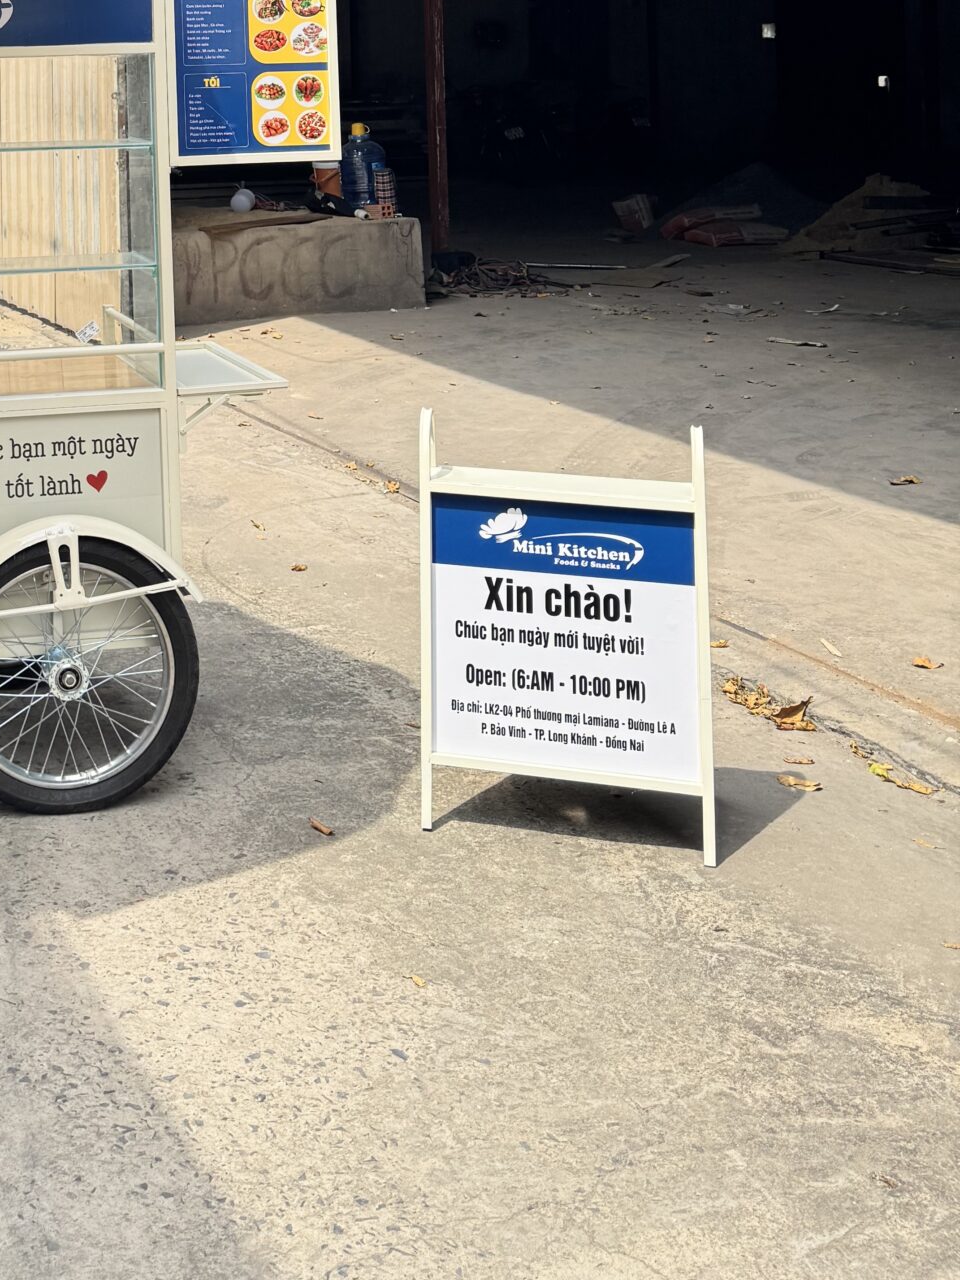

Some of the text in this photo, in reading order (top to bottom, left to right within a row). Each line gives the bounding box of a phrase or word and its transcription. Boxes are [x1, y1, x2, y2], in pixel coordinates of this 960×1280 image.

[203, 76, 220, 88] TỐI
[10, 438, 46, 462] bạn
[51, 436, 86, 459] một
[92, 433, 139, 459] ngày
[5, 473, 82, 498] tốt lành
[513, 539, 631, 562] Mini Kitchen
[554, 557, 579, 567] Foods
[590, 561, 621, 570] Snacks
[484, 576, 632, 623] Xin chào!
[455, 620, 645, 656] Chúc bạn ngày mới tuyệt vời!
[466, 663, 506, 687] Open:
[512, 668, 555, 692] (6:AM
[570, 674, 611, 698] 10:00
[616, 678, 646, 704] PM)
[451, 699, 465, 714] Địa
[485, 702, 513, 717] LK2-04
[515, 705, 532, 719] Phố
[533, 708, 562, 724] thương
[564, 712, 581, 727] mại
[583, 713, 620, 729] Lamiana
[628, 717, 655, 734] Đường
[657, 721, 668, 734] Lê
[670, 723, 676, 735] A
[481, 722, 488, 735] P.
[490, 723, 506, 737] Bảo
[508, 725, 527, 739] Vinh
[534, 728, 546, 741] TP.
[548, 729, 568, 745] Long
[570, 732, 598, 747] Khánh
[629, 738, 645, 752] Nai
